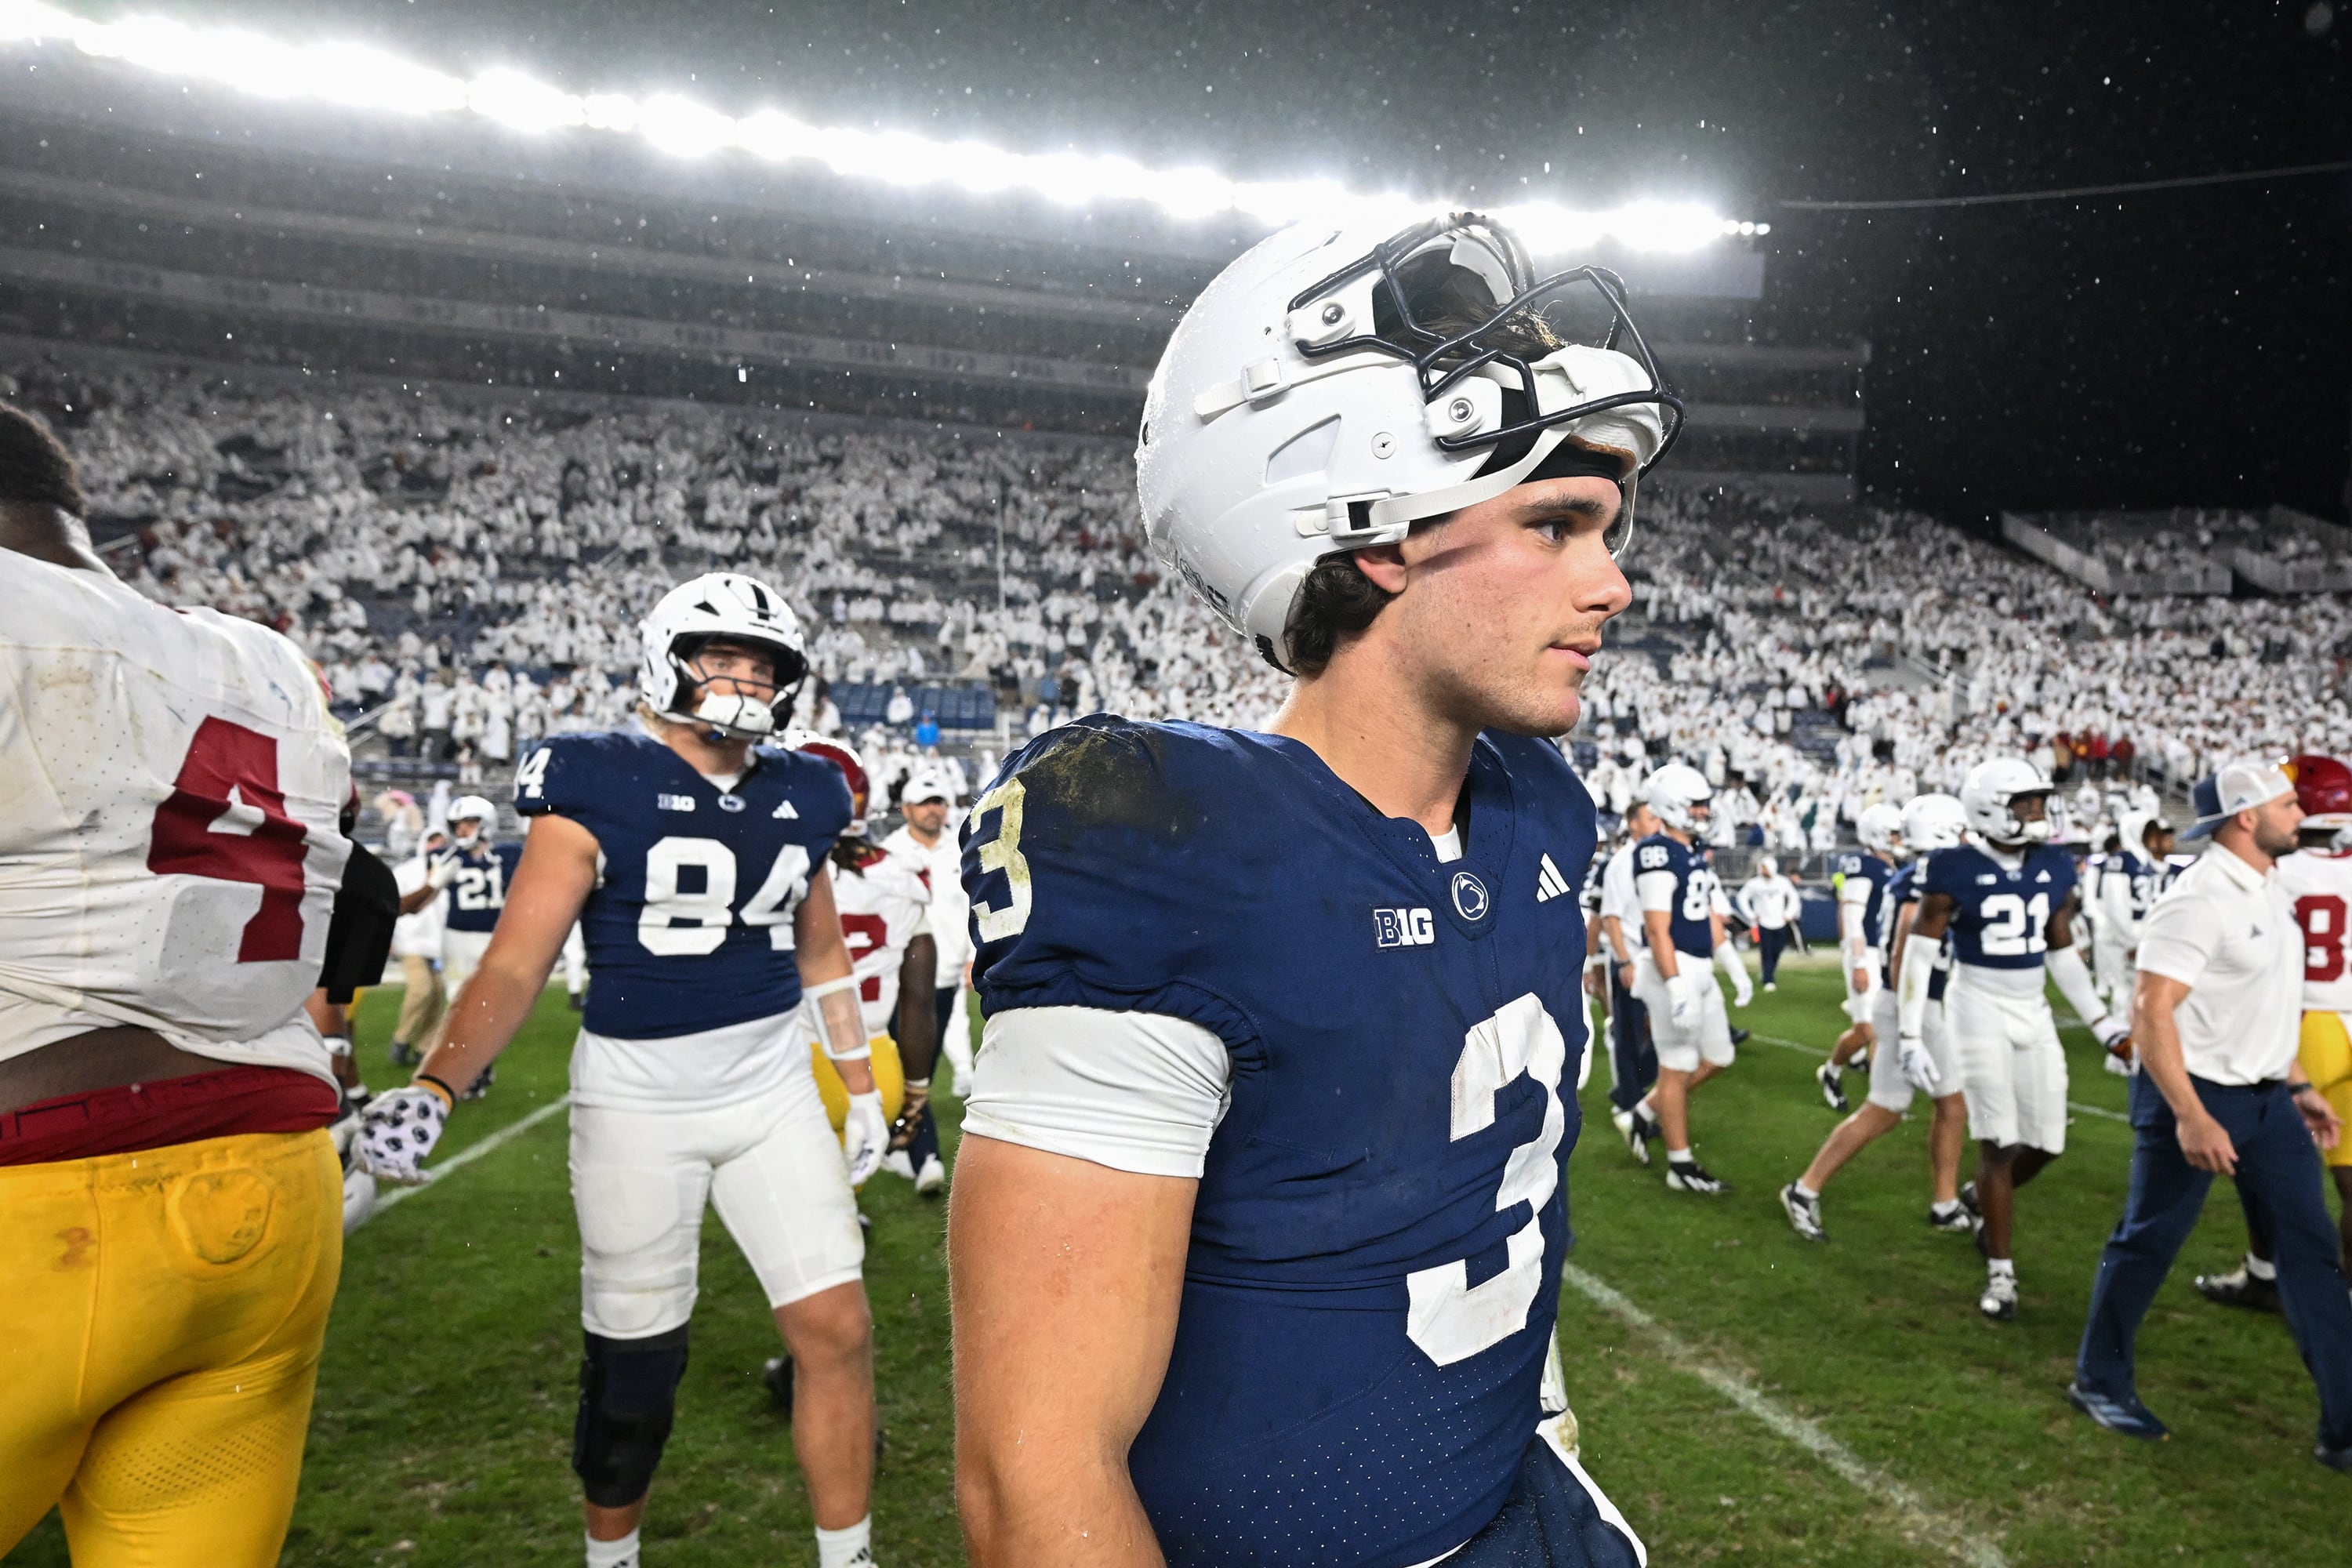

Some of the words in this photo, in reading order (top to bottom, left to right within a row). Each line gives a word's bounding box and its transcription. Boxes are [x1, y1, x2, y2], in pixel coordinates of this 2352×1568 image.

[513, 747, 552, 800] 4
[147, 715, 309, 963] 4
[456, 865, 504, 910] 21
[969, 777, 1033, 943] 3
[638, 836, 811, 956] 84
[1980, 892, 2049, 955] 21
[2294, 895, 2352, 983] 8
[1406, 992, 1566, 1367] 3
